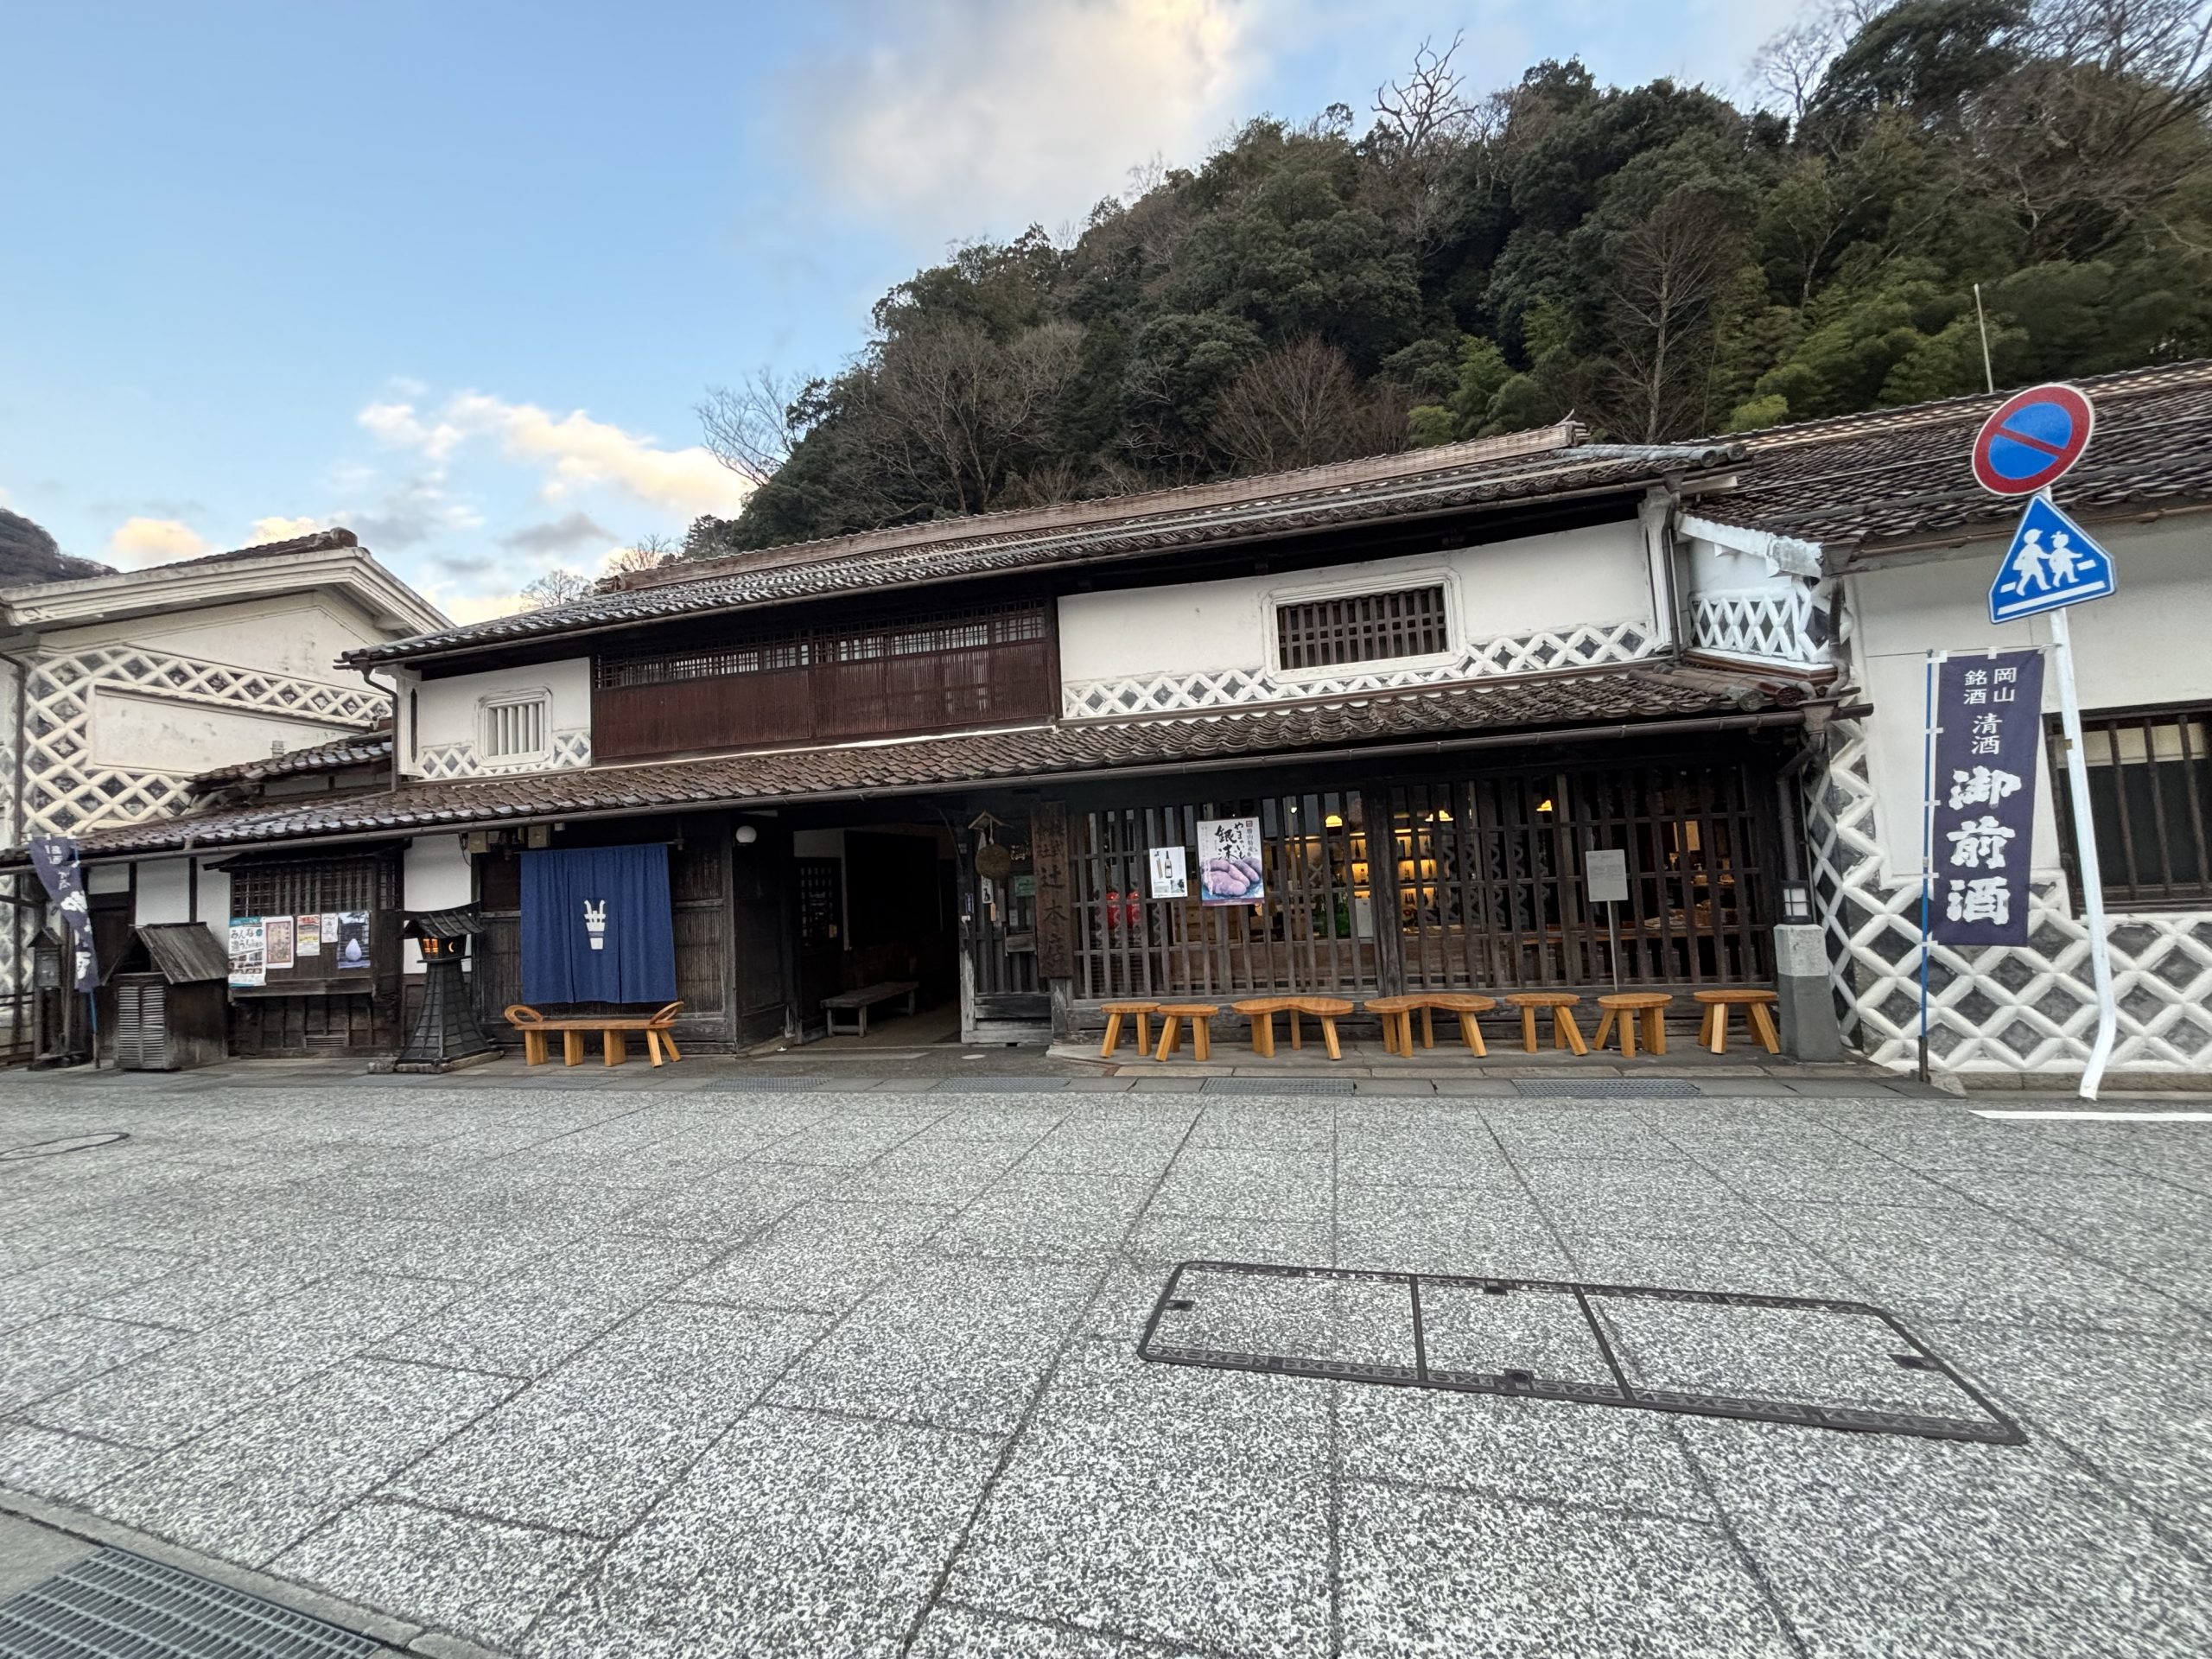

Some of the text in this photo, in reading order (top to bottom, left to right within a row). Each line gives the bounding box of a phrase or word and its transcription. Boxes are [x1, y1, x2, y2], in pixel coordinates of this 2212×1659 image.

[1963, 669, 1987, 705] 銘酒
[1993, 667, 2018, 702] 岡山
[1971, 713, 2003, 754] 清酒
[1946, 766, 2022, 925] 御前酒
